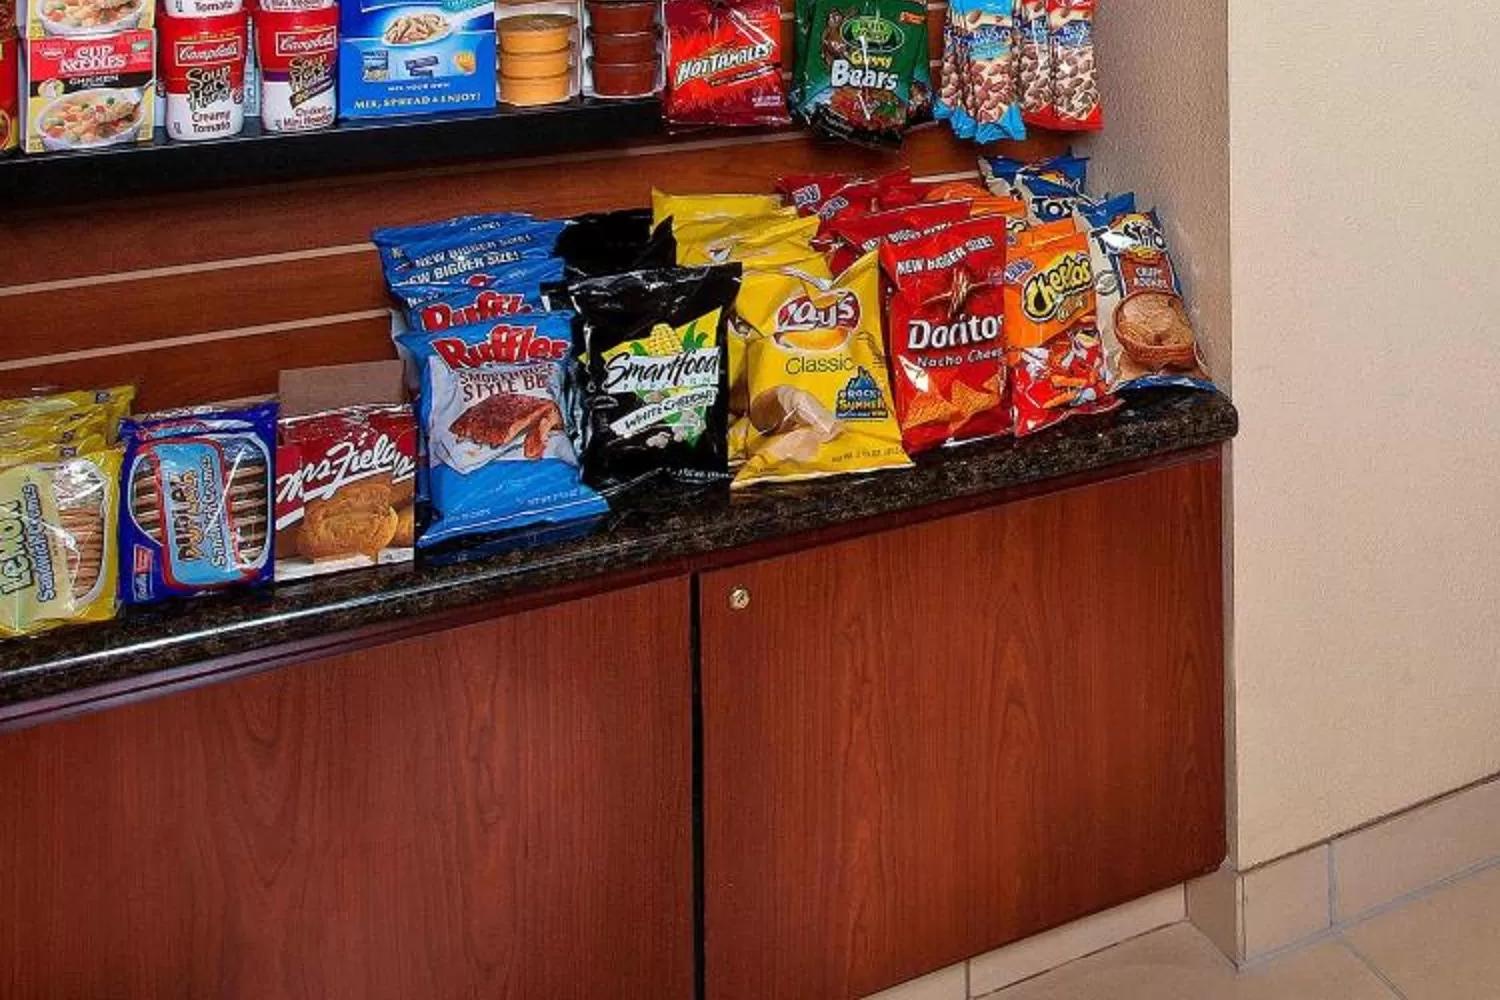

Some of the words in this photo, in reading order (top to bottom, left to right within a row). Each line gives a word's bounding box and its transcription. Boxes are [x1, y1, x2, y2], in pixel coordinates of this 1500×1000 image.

[194, 0, 234, 13] Tomato
[187, 66, 230, 85] Soup
[831, 60, 899, 90] Bears
[192, 112, 231, 126] Creamy
[192, 120, 231, 134] Tomato
[896, 260, 923, 275] NEW
[1023, 255, 1093, 322] Cheetos
[606, 350, 720, 389] Smartfood
[785, 354, 854, 375] Classic
[917, 353, 962, 369] Nacho
